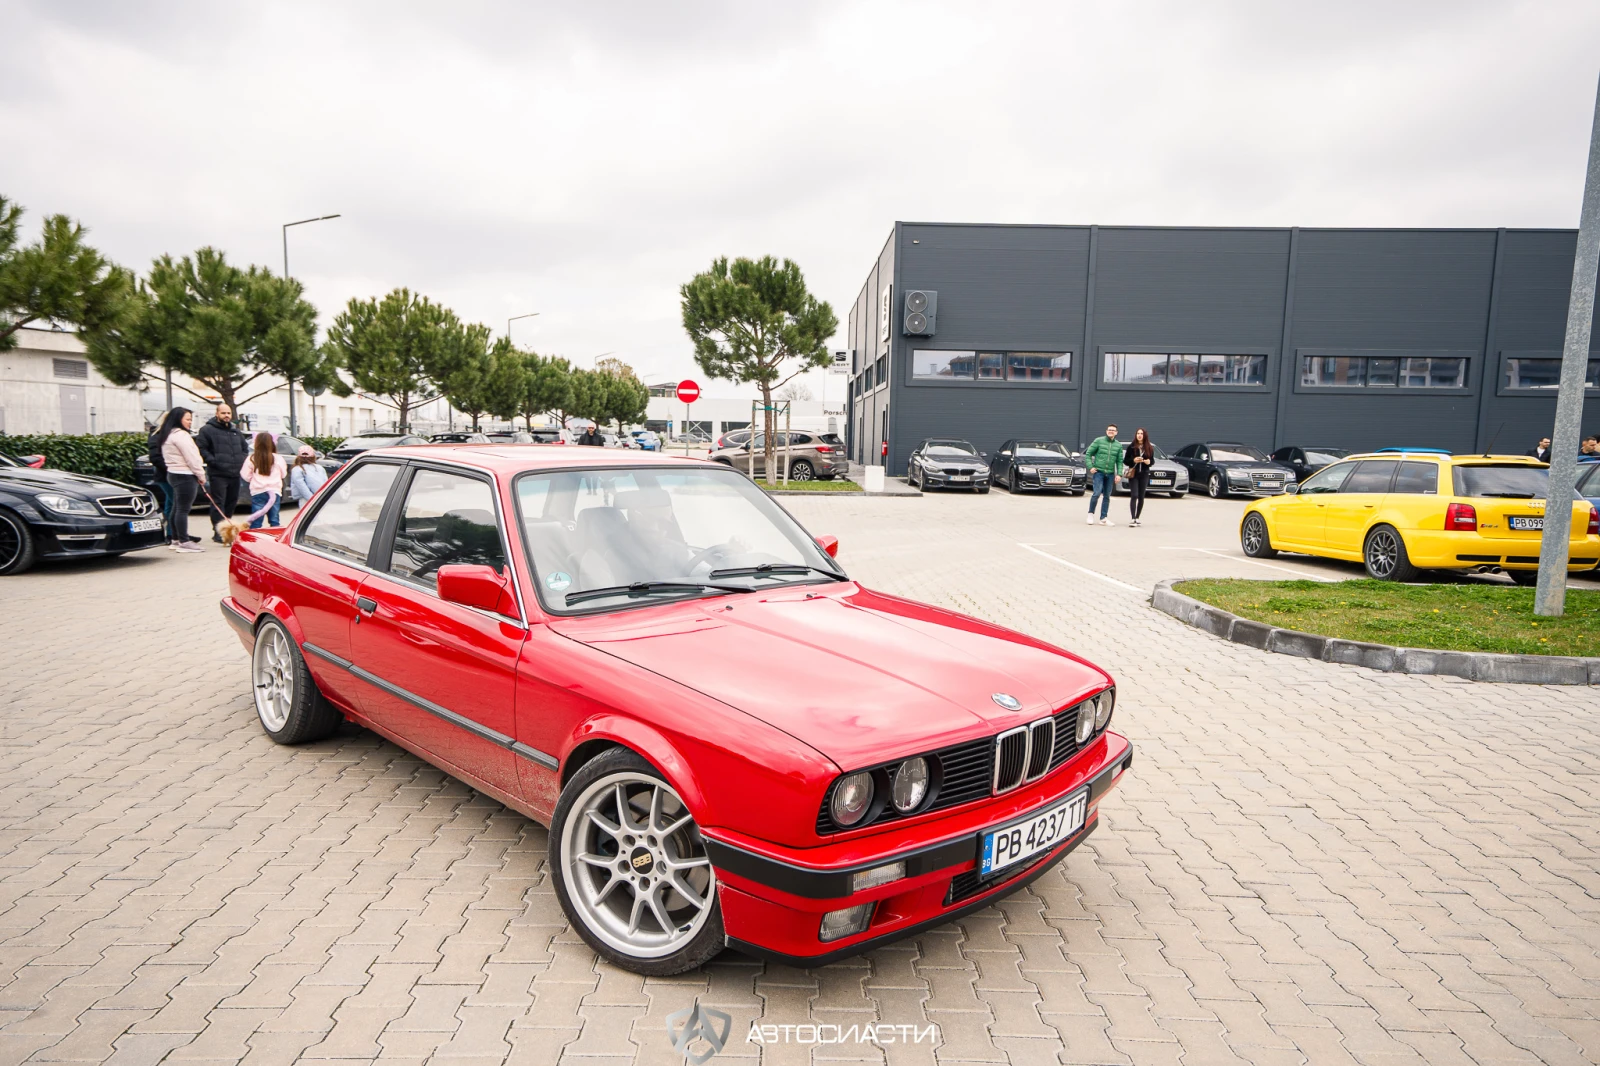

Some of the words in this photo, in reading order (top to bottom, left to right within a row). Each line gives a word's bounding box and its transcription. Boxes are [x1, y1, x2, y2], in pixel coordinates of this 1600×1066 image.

[1515, 518, 1527, 528] PB
[995, 829, 1022, 865] PB
[1025, 807, 1067, 851] 4237
[1069, 795, 1086, 830] TT
